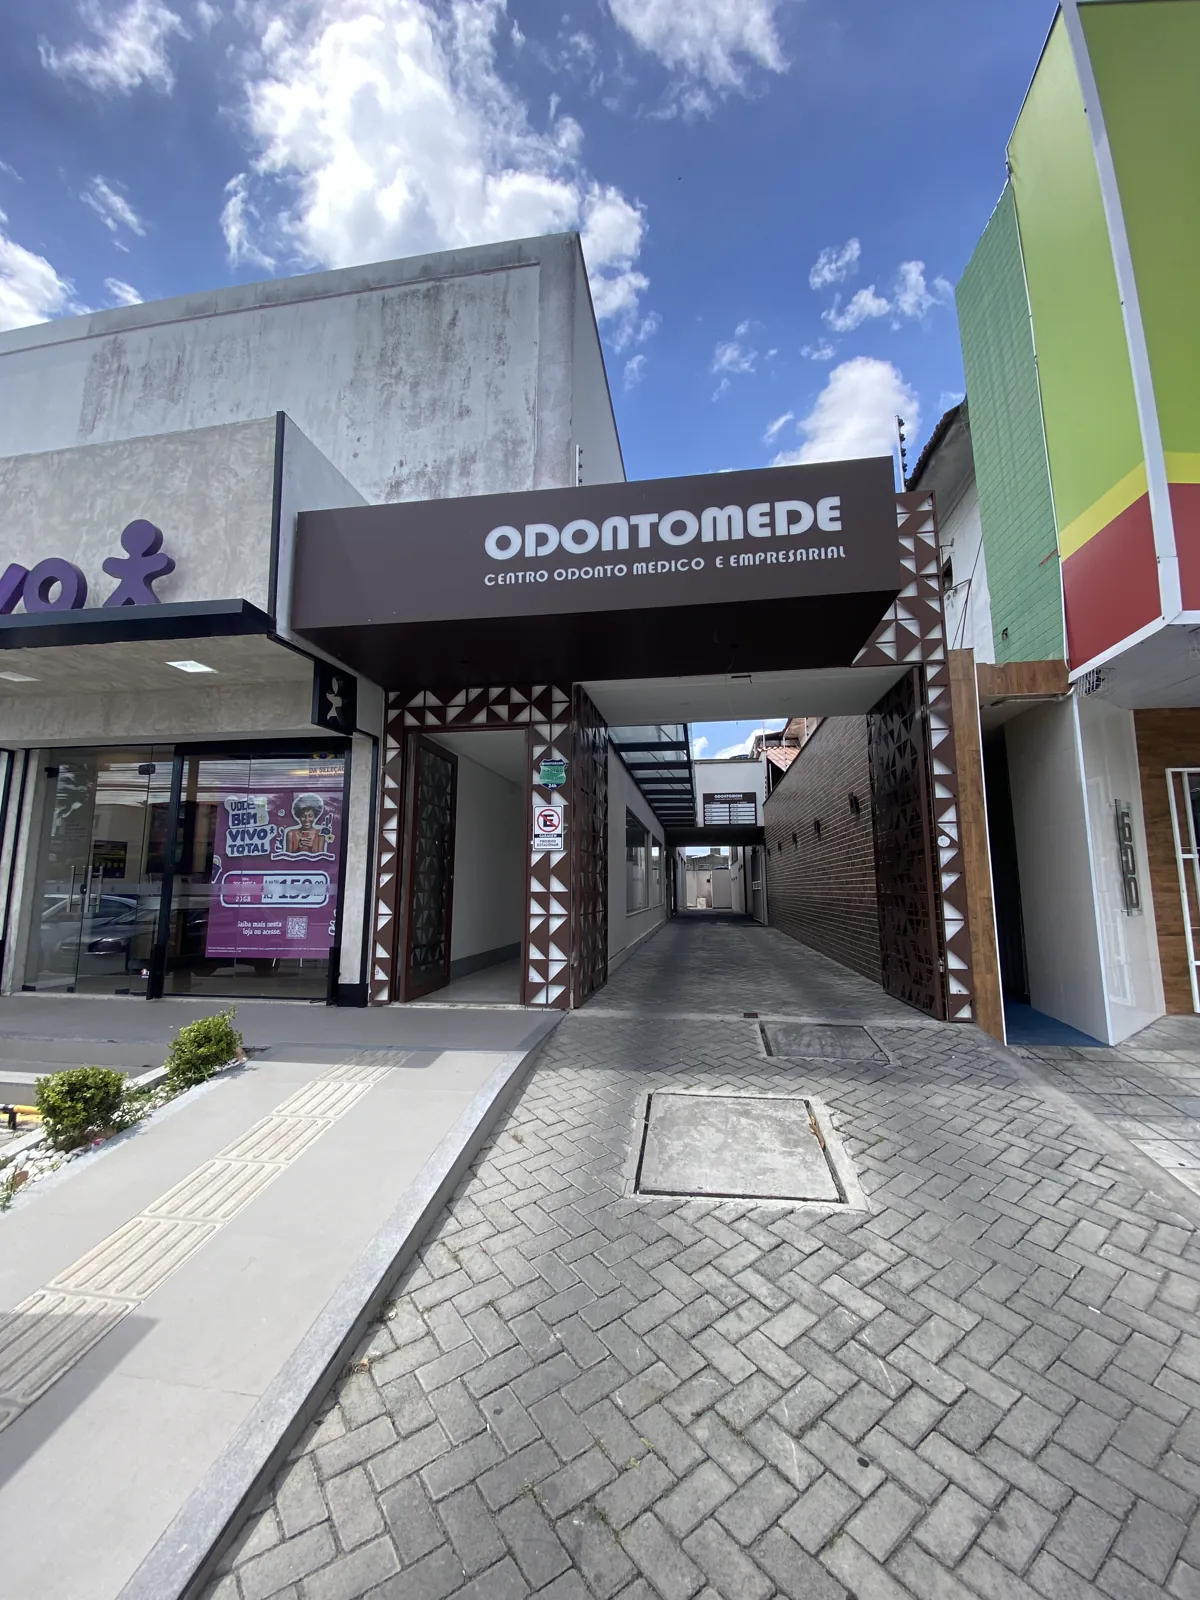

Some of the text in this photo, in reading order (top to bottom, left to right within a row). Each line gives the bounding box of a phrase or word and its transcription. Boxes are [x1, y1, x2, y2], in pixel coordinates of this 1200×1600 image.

[484, 495, 842, 561] ODONTOMEDE
[484, 545, 846, 587] CENTRO ODONTO MEDICO E EMPRESARIAL
[231, 812, 258, 827] BEM
[228, 828, 268, 842] VIVO
[228, 843, 269, 855] TOTAL
[252, 920, 265, 928] mais
[266, 920, 283, 928] nesta
